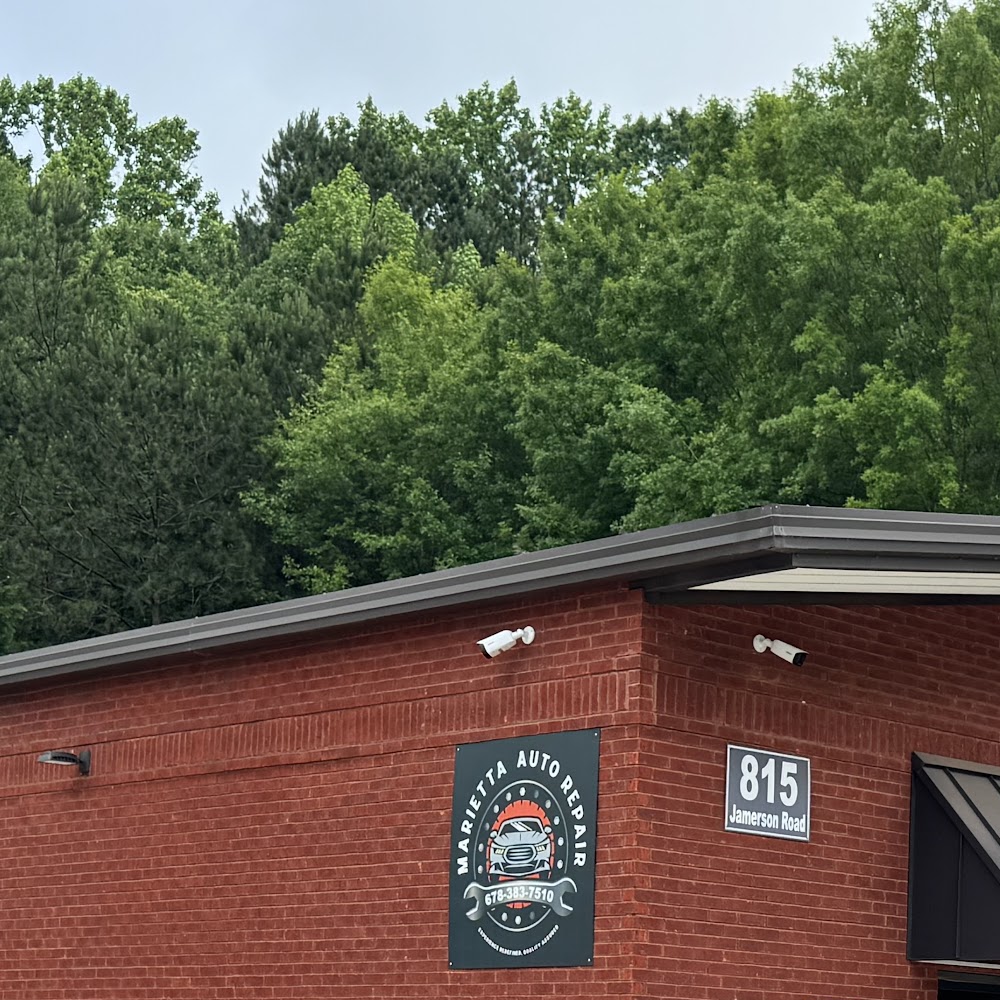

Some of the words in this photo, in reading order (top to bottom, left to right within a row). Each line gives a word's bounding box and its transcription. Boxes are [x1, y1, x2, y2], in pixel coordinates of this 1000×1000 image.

[740, 754, 798, 807] 815
[457, 760, 508, 876] MARIETTA
[516, 750, 561, 778] AUTO
[560, 774, 587, 867] REPAIR
[729, 803, 779, 829] Jamerson
[781, 811, 806, 833] Road
[484, 886, 554, 907] 678-383-7510
